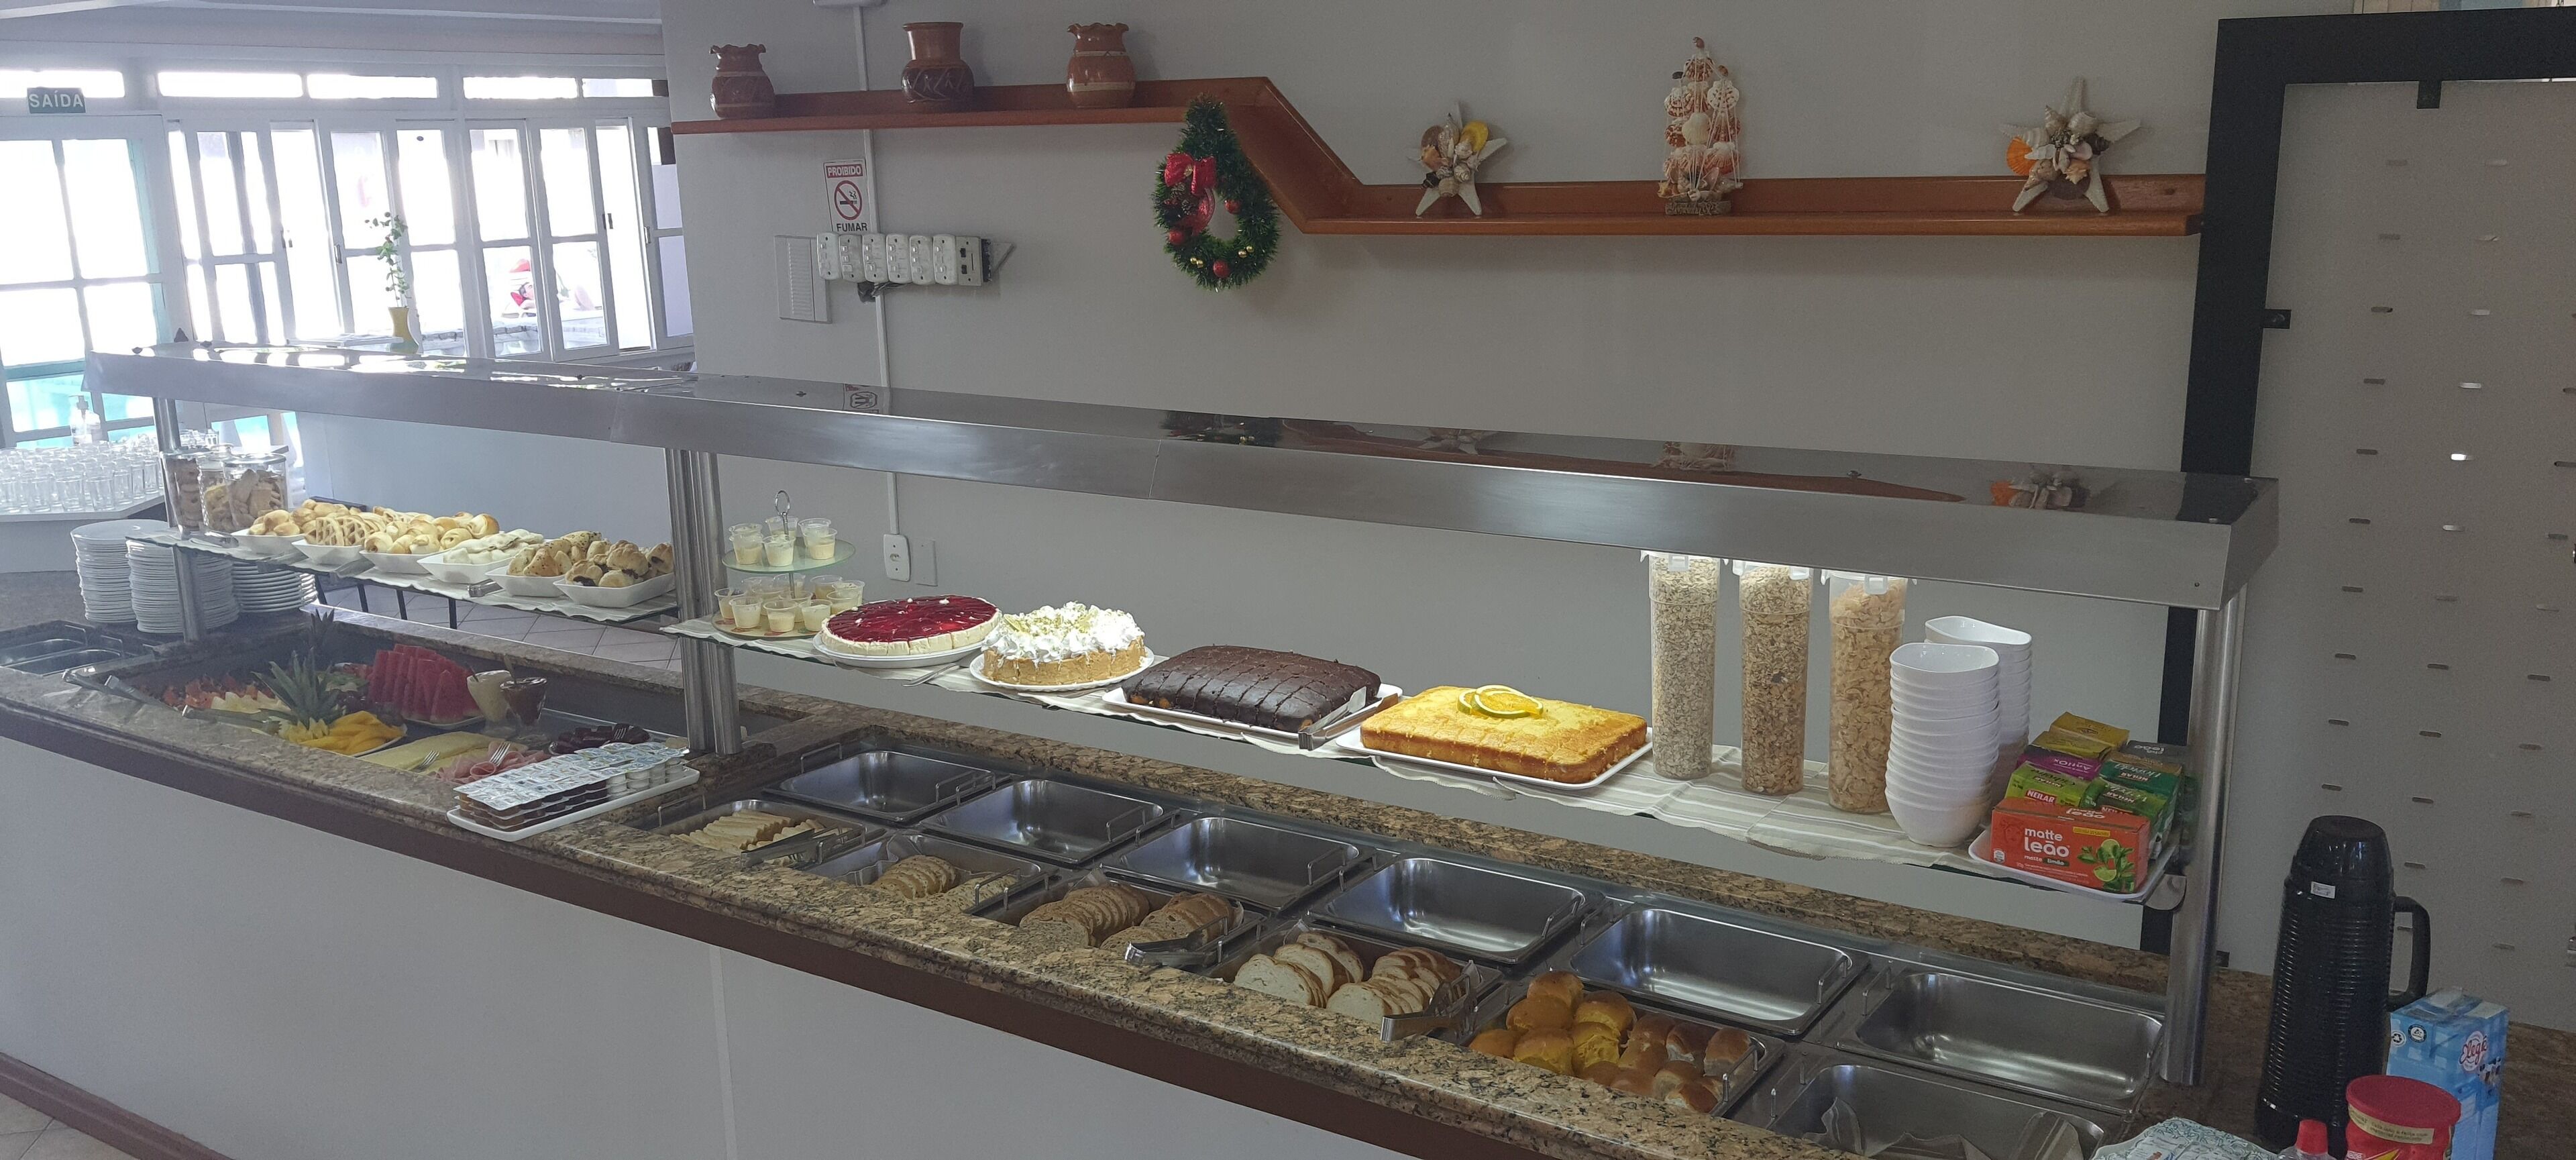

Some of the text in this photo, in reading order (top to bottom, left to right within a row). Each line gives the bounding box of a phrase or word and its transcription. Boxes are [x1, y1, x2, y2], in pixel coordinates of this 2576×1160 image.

[29, 91, 83, 108] SAÍDA
[828, 166, 861, 176] PROIBIDO
[836, 222, 868, 232] FUMAR
[2027, 790, 2056, 804] NEILAR
[2025, 827, 2063, 841] matte
[2025, 837, 2070, 857] leão
